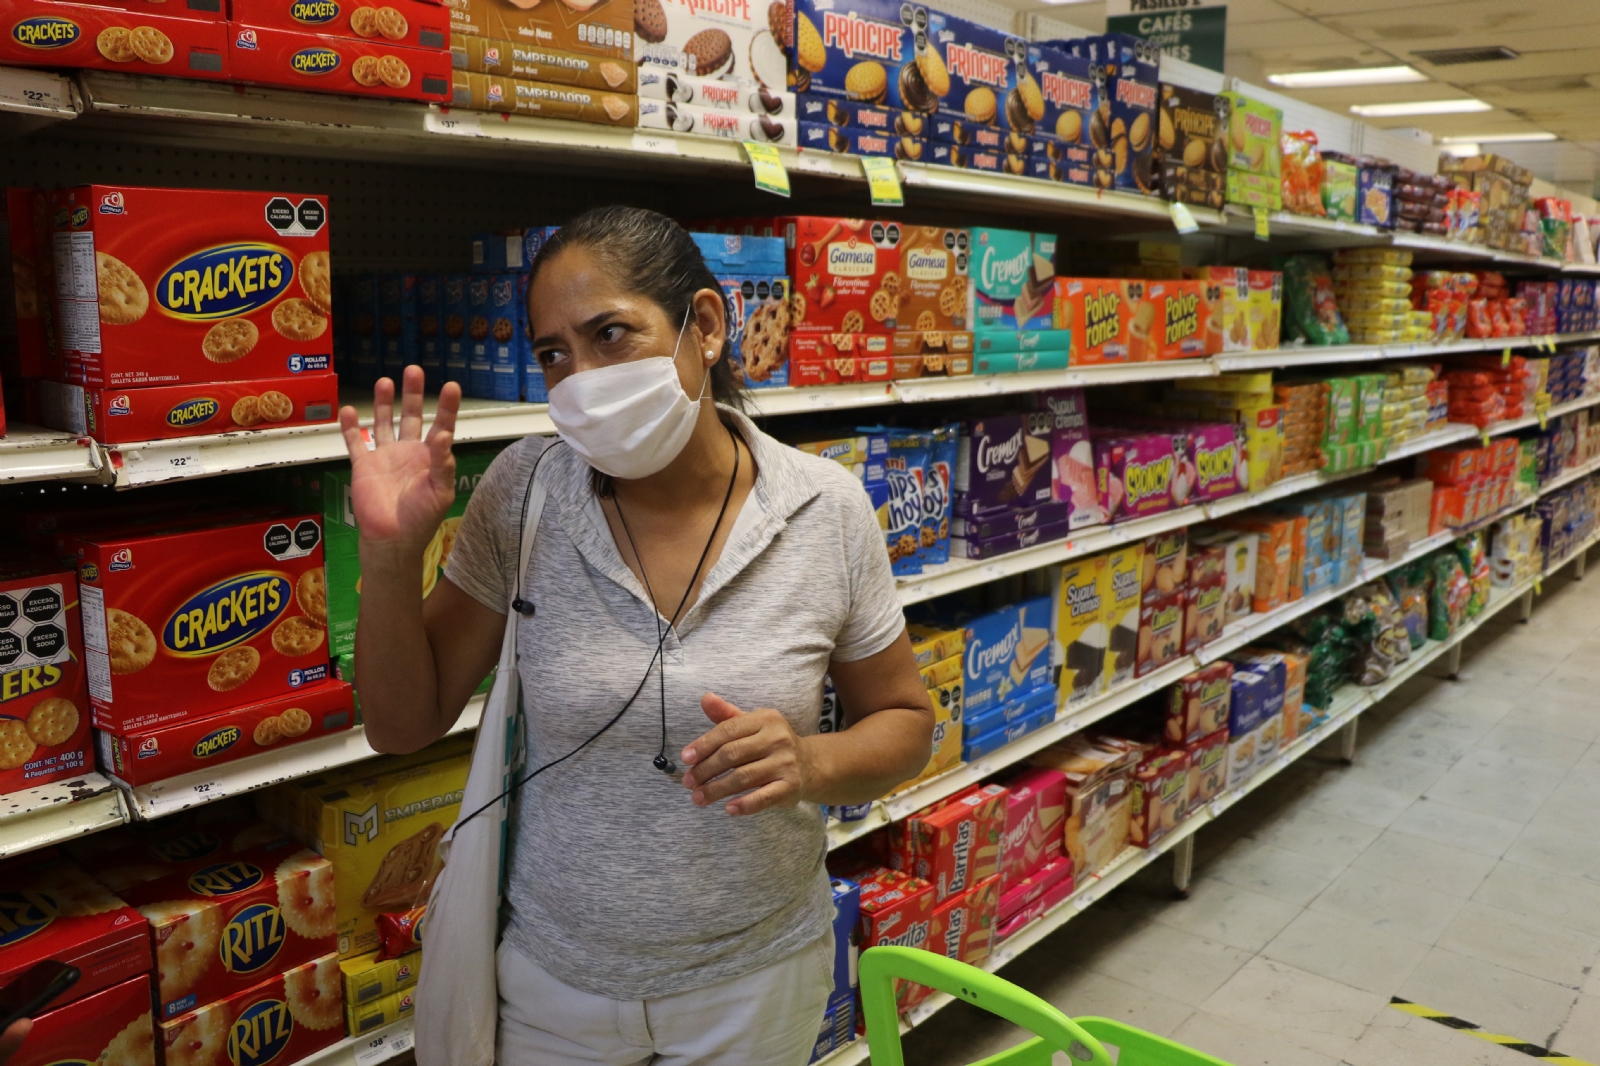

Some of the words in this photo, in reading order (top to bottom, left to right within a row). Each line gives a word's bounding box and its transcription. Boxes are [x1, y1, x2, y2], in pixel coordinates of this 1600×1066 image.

[294, 2, 334, 19] CRACKETS
[18, 23, 74, 43] CRACKETS
[518, 26, 534, 36] Sabor
[536, 28, 552, 40] Nuez
[1138, 12, 1192, 34] CAFÉS
[295, 53, 336, 70] CRACKETS
[513, 50, 589, 70] EMPERADOR
[23, 90, 44, 101] $22
[516, 86, 591, 104] EMPERADOR
[830, 248, 874, 265] Gamesa
[909, 256, 946, 269] Gamesa
[981, 246, 1030, 290] Cremax
[168, 254, 282, 312] CRACKETS
[832, 276, 870, 288] Florentinas
[1086, 315, 1120, 350] rones
[1166, 312, 1198, 346] rones
[290, 356, 300, 370] 5
[171, 402, 214, 424] CRACKETS
[820, 443, 850, 458] OREO
[977, 428, 1022, 474] Cremax
[170, 458, 186, 466] $22
[1126, 457, 1172, 505] SPONCH
[29, 597, 54, 606] EXCESO
[1066, 578, 1096, 605] Suavi
[26, 604, 58, 613] AZÚCARES
[174, 578, 281, 648] CRACKETS
[1072, 596, 1100, 616] cremas
[32, 632, 58, 642] EXCESO
[36, 640, 56, 648] SODIO
[968, 622, 1019, 680] Cremax
[2, 664, 62, 700] ERS
[290, 672, 300, 686] 5
[304, 666, 324, 675] ROLLOS
[197, 728, 237, 756] CRACKETS
[24, 762, 44, 771] CONT.
[44, 756, 58, 765] NET.
[60, 752, 76, 761] 400
[78, 751, 83, 760] g
[30, 768, 56, 778] Paquetes
[66, 760, 78, 768] 100
[194, 784, 210, 792] $22
[384, 789, 464, 824] EMPERAD
[948, 820, 970, 894] Barritas
[188, 862, 258, 897] RITZ
[222, 907, 282, 973] RITZ
[168, 1002, 176, 1014] 8
[230, 1000, 290, 1066] RITZ
